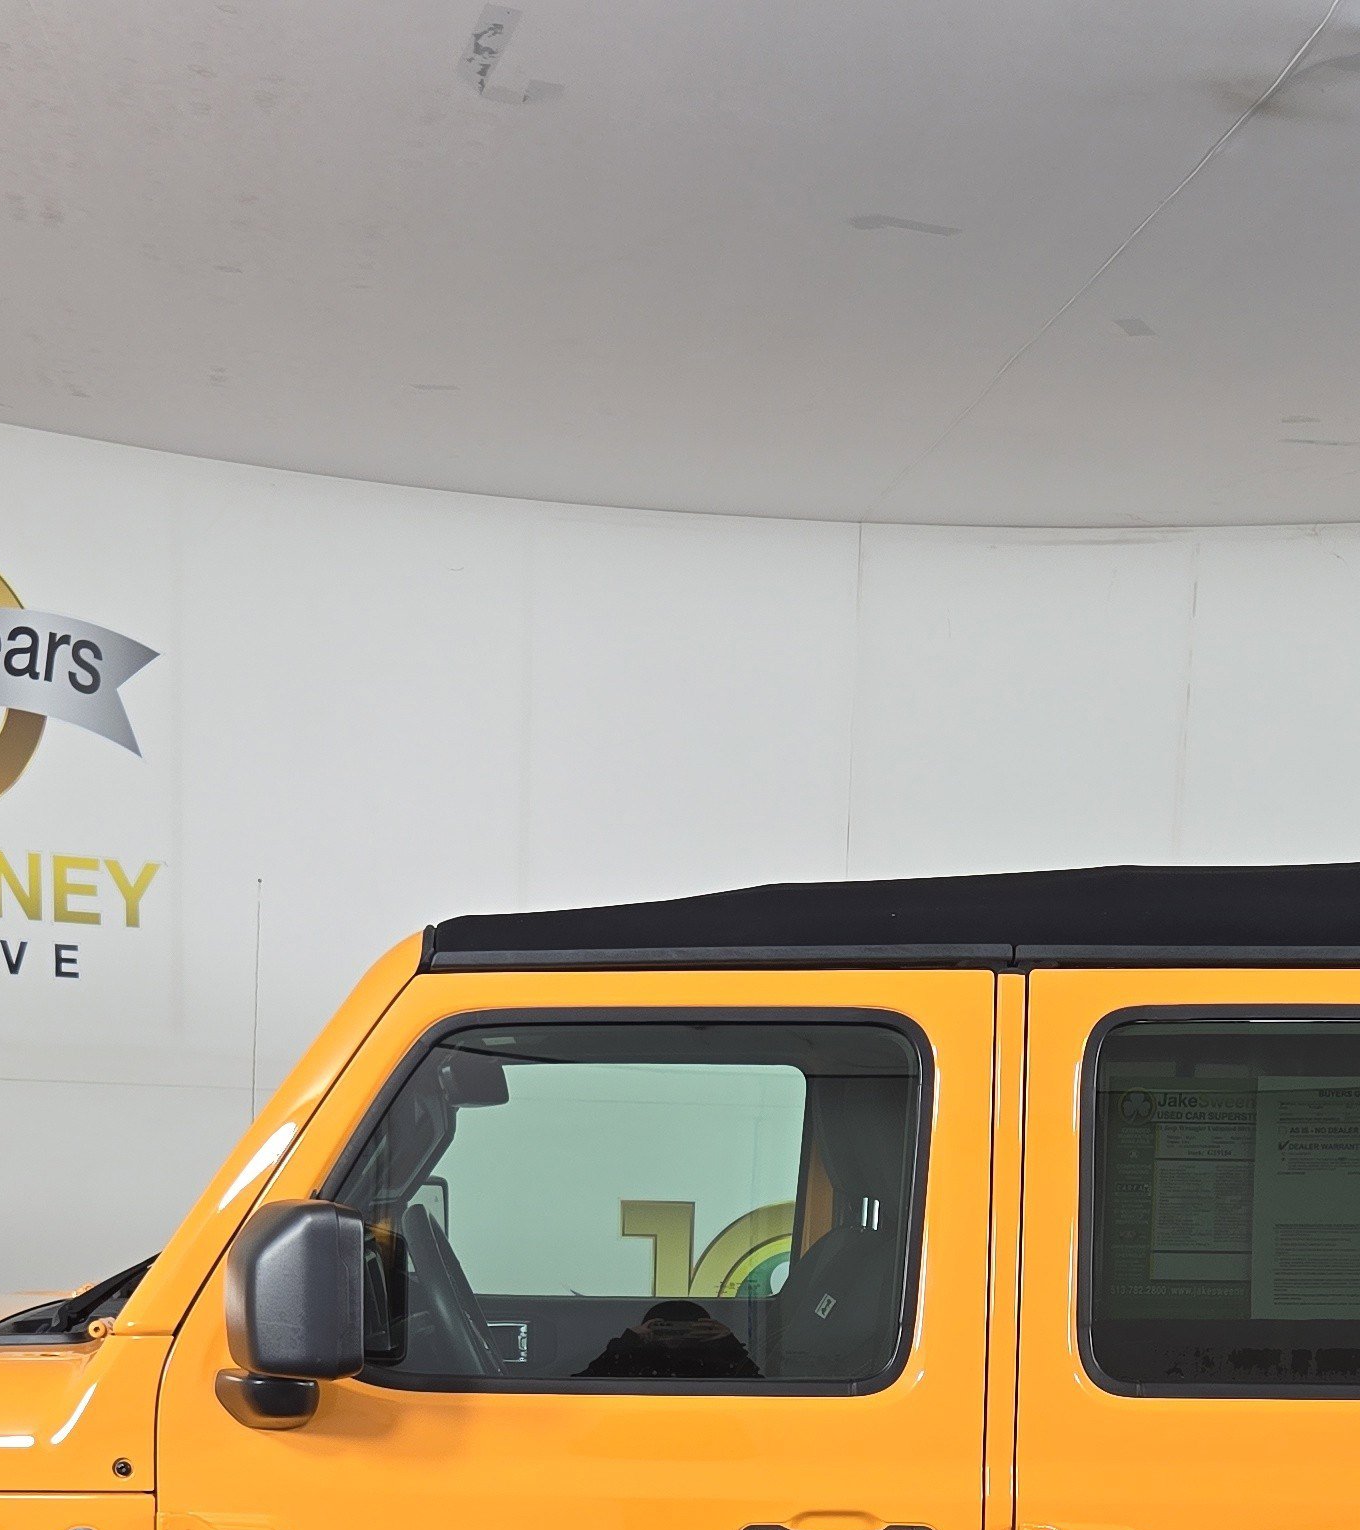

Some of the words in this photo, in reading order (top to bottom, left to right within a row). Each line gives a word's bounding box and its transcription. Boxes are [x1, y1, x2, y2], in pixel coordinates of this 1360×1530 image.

[1157, 1111, 1183, 1120] USED
[1185, 1111, 1206, 1120] CAR
[1314, 1126, 1327, 1134] NO
[1328, 1126, 1359, 1134] DEALER
[1288, 1143, 1319, 1151] DEALER
